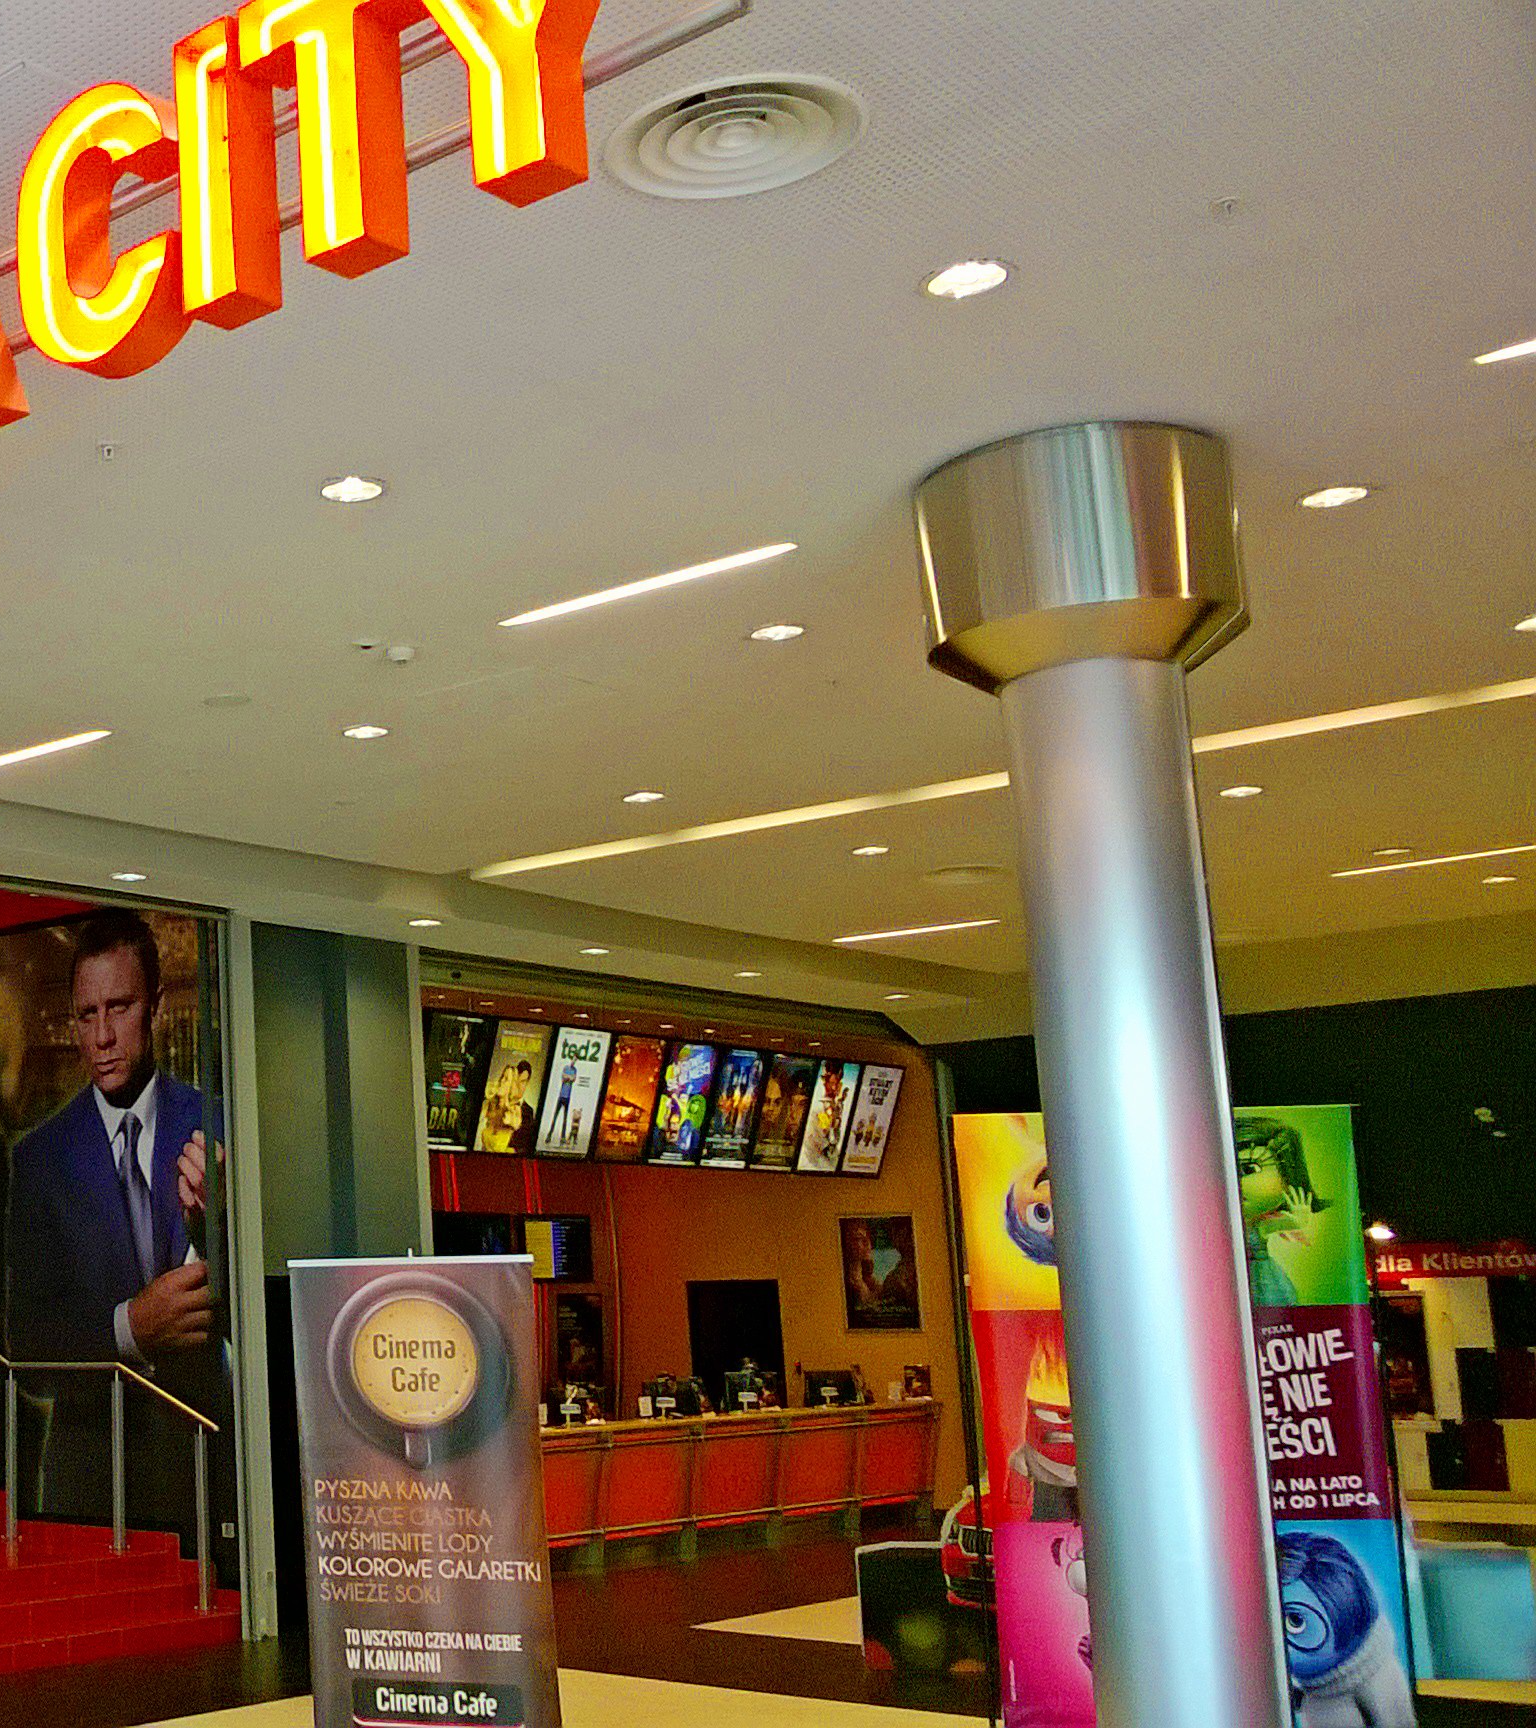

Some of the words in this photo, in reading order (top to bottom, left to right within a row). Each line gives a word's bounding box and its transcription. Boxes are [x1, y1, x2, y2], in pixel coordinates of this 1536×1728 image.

[17, 0, 601, 378] CITY
[1374, 1254, 1413, 1273] dla
[373, 1333, 456, 1360] Cinema
[1258, 1328, 1354, 1377] ŁOWIE
[391, 1366, 441, 1393] Cafe
[1278, 1372, 1333, 1412] NIE
[1266, 1415, 1337, 1461] EŚCI
[315, 1479, 392, 1499] PYSZNA
[397, 1481, 453, 1501] KAWA
[1290, 1477, 1317, 1492] NA
[1320, 1475, 1363, 1491] LATO
[1289, 1494, 1317, 1509] OD
[1320, 1494, 1329, 1508] 1
[1331, 1491, 1381, 1508] LIPCA
[316, 1505, 406, 1526] KUSZĄCE
[410, 1507, 493, 1528] CIASTKA
[316, 1527, 433, 1553] WYŚMIENITE
[438, 1534, 493, 1553] LODY
[318, 1556, 433, 1579] KOLOROWE
[438, 1559, 542, 1582] GALARETKI
[320, 1579, 390, 1602] ŚWIEŻE
[395, 1585, 441, 1603] SOKI
[345, 1628, 361, 1646] TO
[362, 1629, 423, 1648] WSZYSTKO
[425, 1631, 463, 1650] CZEKA
[465, 1633, 483, 1651] NA
[484, 1633, 523, 1652] CIEBIE
[346, 1649, 361, 1670] W
[364, 1651, 442, 1673] KAWIARNI
[376, 1687, 449, 1715] Cinema
[453, 1690, 499, 1718] Cafe
